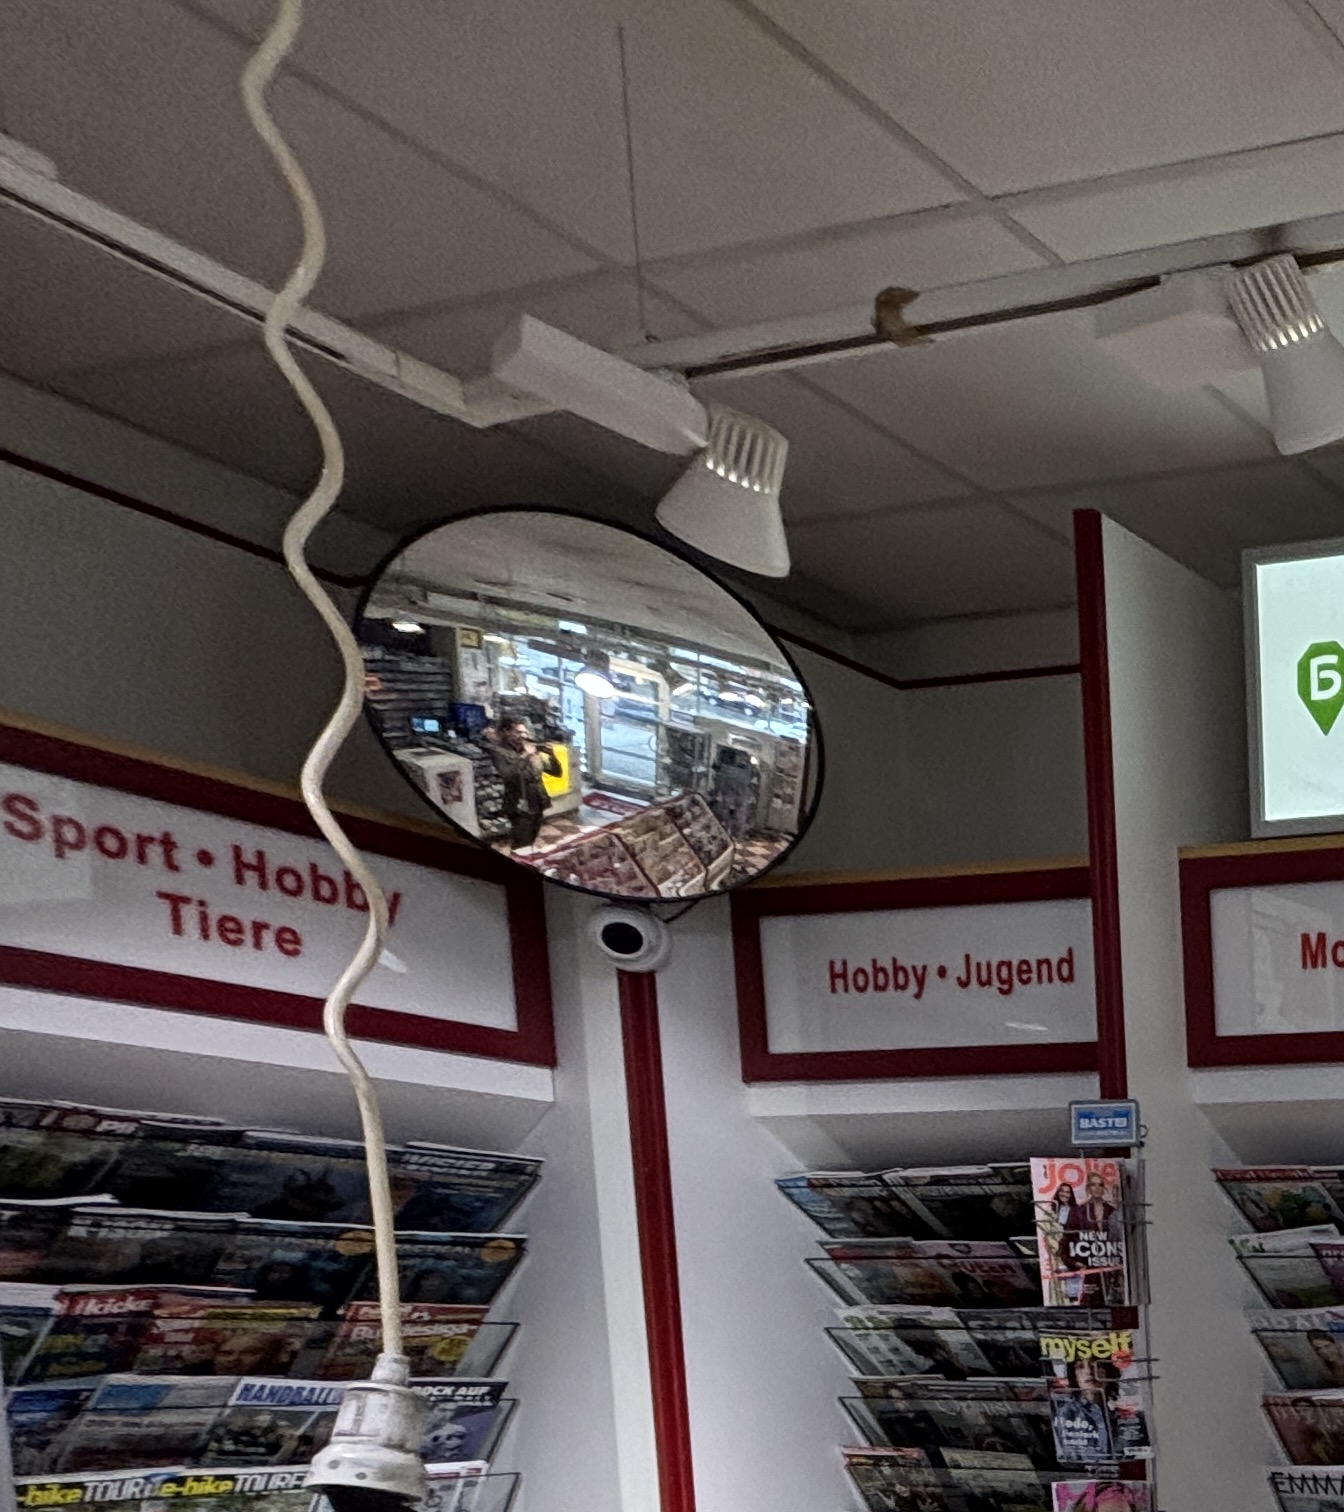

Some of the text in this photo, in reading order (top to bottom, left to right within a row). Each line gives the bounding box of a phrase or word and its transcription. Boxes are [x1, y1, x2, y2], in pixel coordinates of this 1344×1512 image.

[4, 794, 176, 874] Sport
[156, 888, 304, 959] Tiere
[829, 947, 1075, 999] Hobby Jugend
